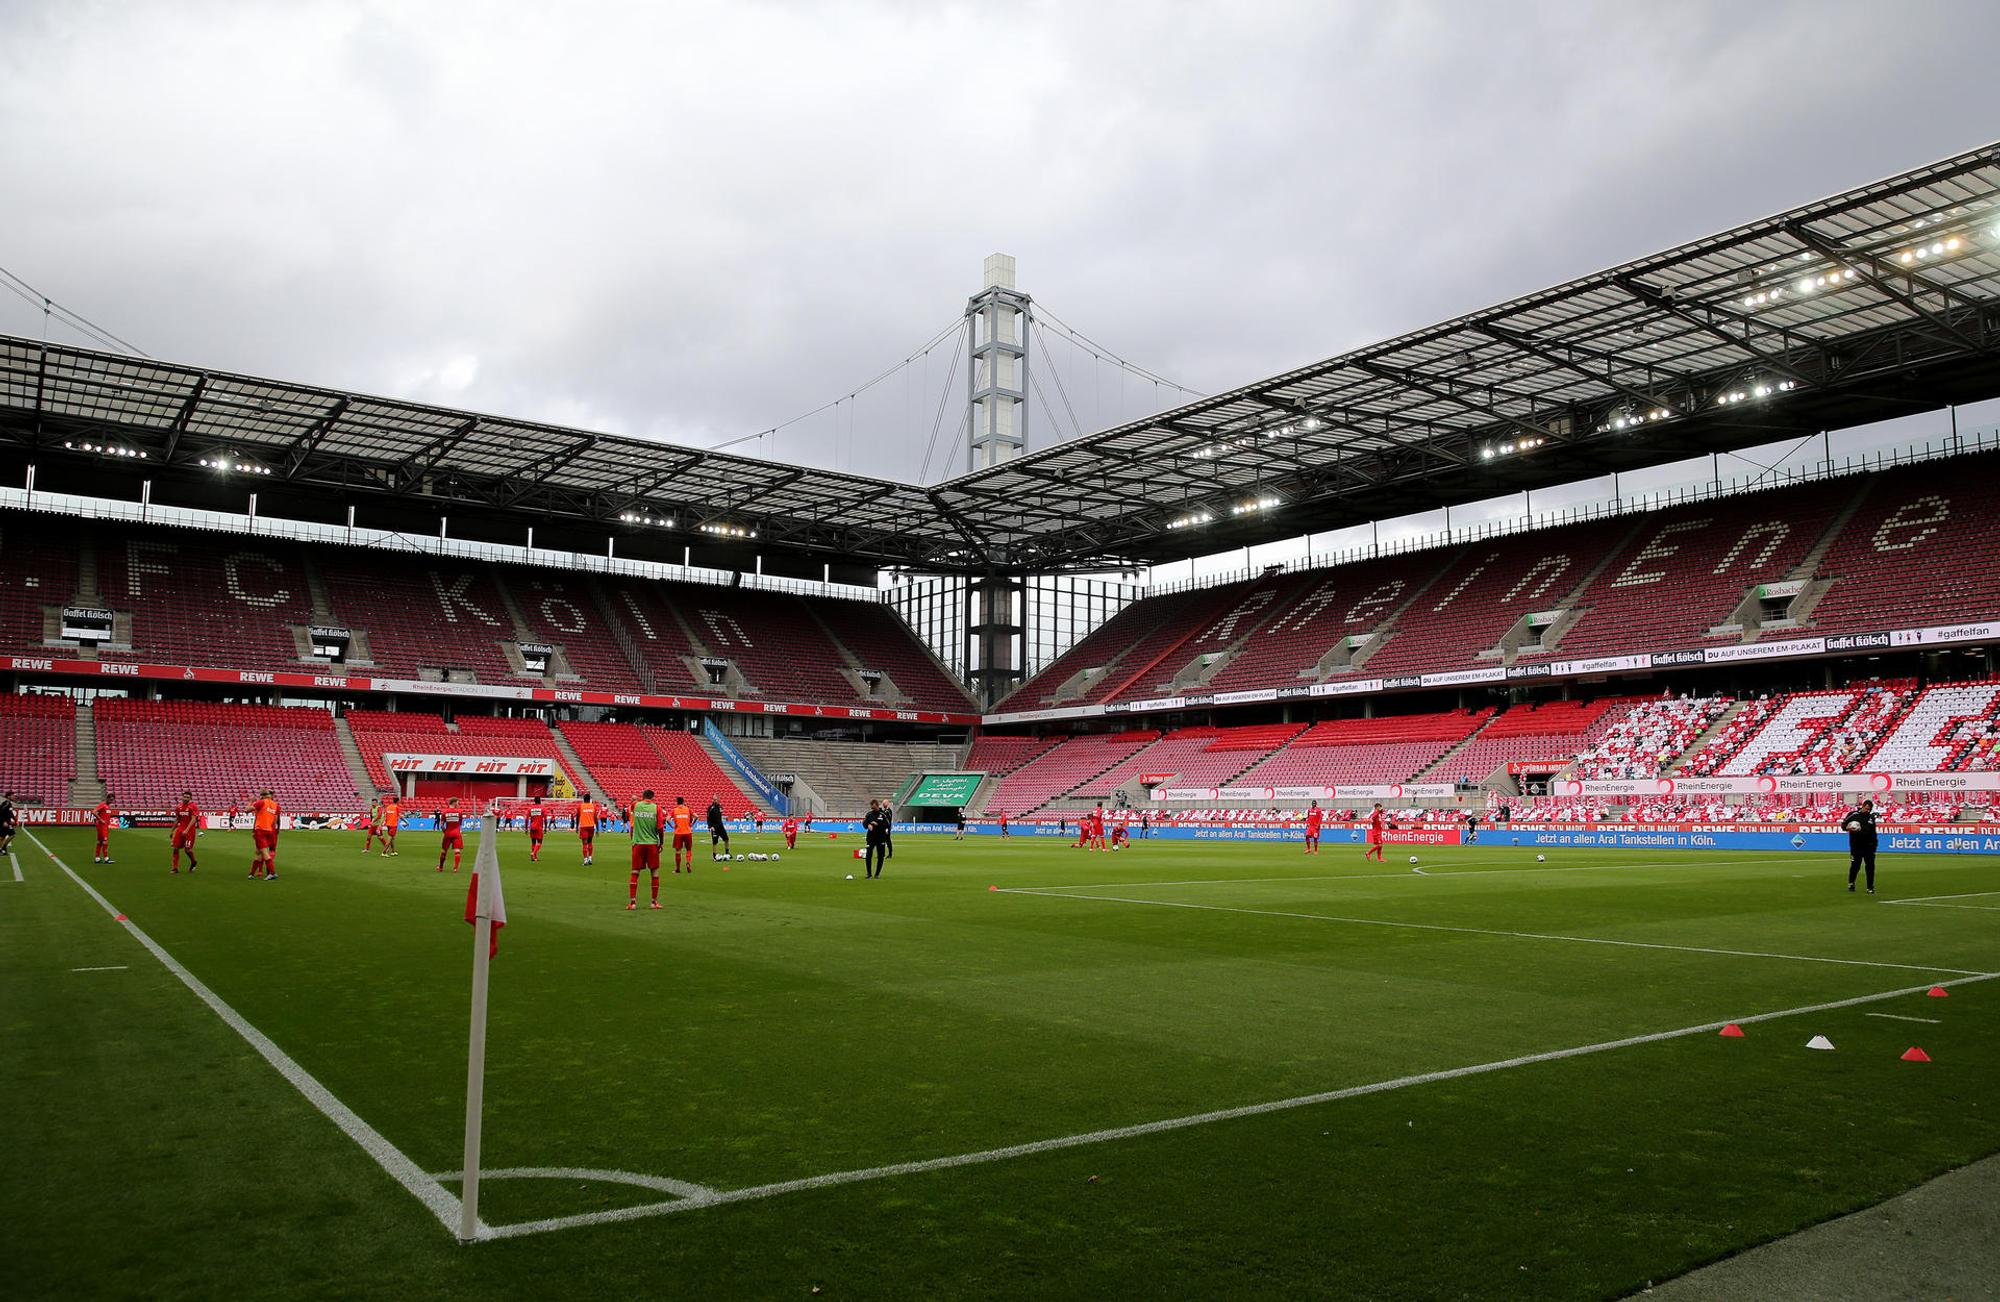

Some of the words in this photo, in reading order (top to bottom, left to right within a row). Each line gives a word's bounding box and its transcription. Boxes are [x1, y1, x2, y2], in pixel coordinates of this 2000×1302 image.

[63, 609, 86, 618] Gaffel
[87, 609, 113, 620] Kölsch
[1937, 626, 1990, 639] #gaffelfan
[1827, 638, 1855, 650] Gaffel
[1856, 634, 1889, 647] Kölsch
[1737, 647, 1775, 656] UNSEREM
[1776, 642, 1822, 653] EM-PLAKAT
[1652, 654, 1676, 664] Gaffel
[1677, 651, 1704, 663] Kölsch
[12, 658, 52, 670] REWE
[101, 664, 139, 675] REWE
[1582, 661, 1617, 670] #gaffelfan
[1507, 667, 1527, 677] Gaffel
[1527, 664, 1550, 675] Kölsch
[240, 672, 274, 683] REWE
[314, 677, 347, 687] REWE
[1383, 678, 1401, 688] Gaffel
[1401, 676, 1421, 686] Kölsch
[555, 691, 582, 701] REWE
[614, 695, 641, 705] REWE
[711, 701, 735, 710] REWE
[764, 703, 787, 713] REWE
[849, 709, 871, 718] REWE
[896, 712, 918, 720] REWE
[391, 758, 423, 770] HIT
[434, 760, 465, 771] HIT
[475, 762, 507, 772] HIT
[517, 763, 547, 774] HIT
[1522, 763, 1547, 773] SPÜRBAR
[1677, 782, 1733, 792] RheinEnergie
[1780, 780, 1842, 790] RheinEnergie
[1896, 777, 1966, 788] RheinEnergie
[1585, 784, 1635, 794] RheinEnergie
[61, 810, 81, 822] DEIN
[695, 821, 708, 830] Jetz
[1194, 829, 1208, 838] Jetzt
[1382, 832, 1444, 843] RheinEnergie
[1535, 833, 1557, 843] Jetzt
[1560, 836, 1570, 844] an
[1573, 834, 1595, 844] allen
[1598, 834, 1616, 844] Aral
[1619, 834, 1674, 845] Tankstellen
[1677, 835, 1687, 845] in
[1691, 834, 1716, 846] Köln.
[1889, 837, 1921, 849] Jetzt
[1925, 839, 1942, 849] an
